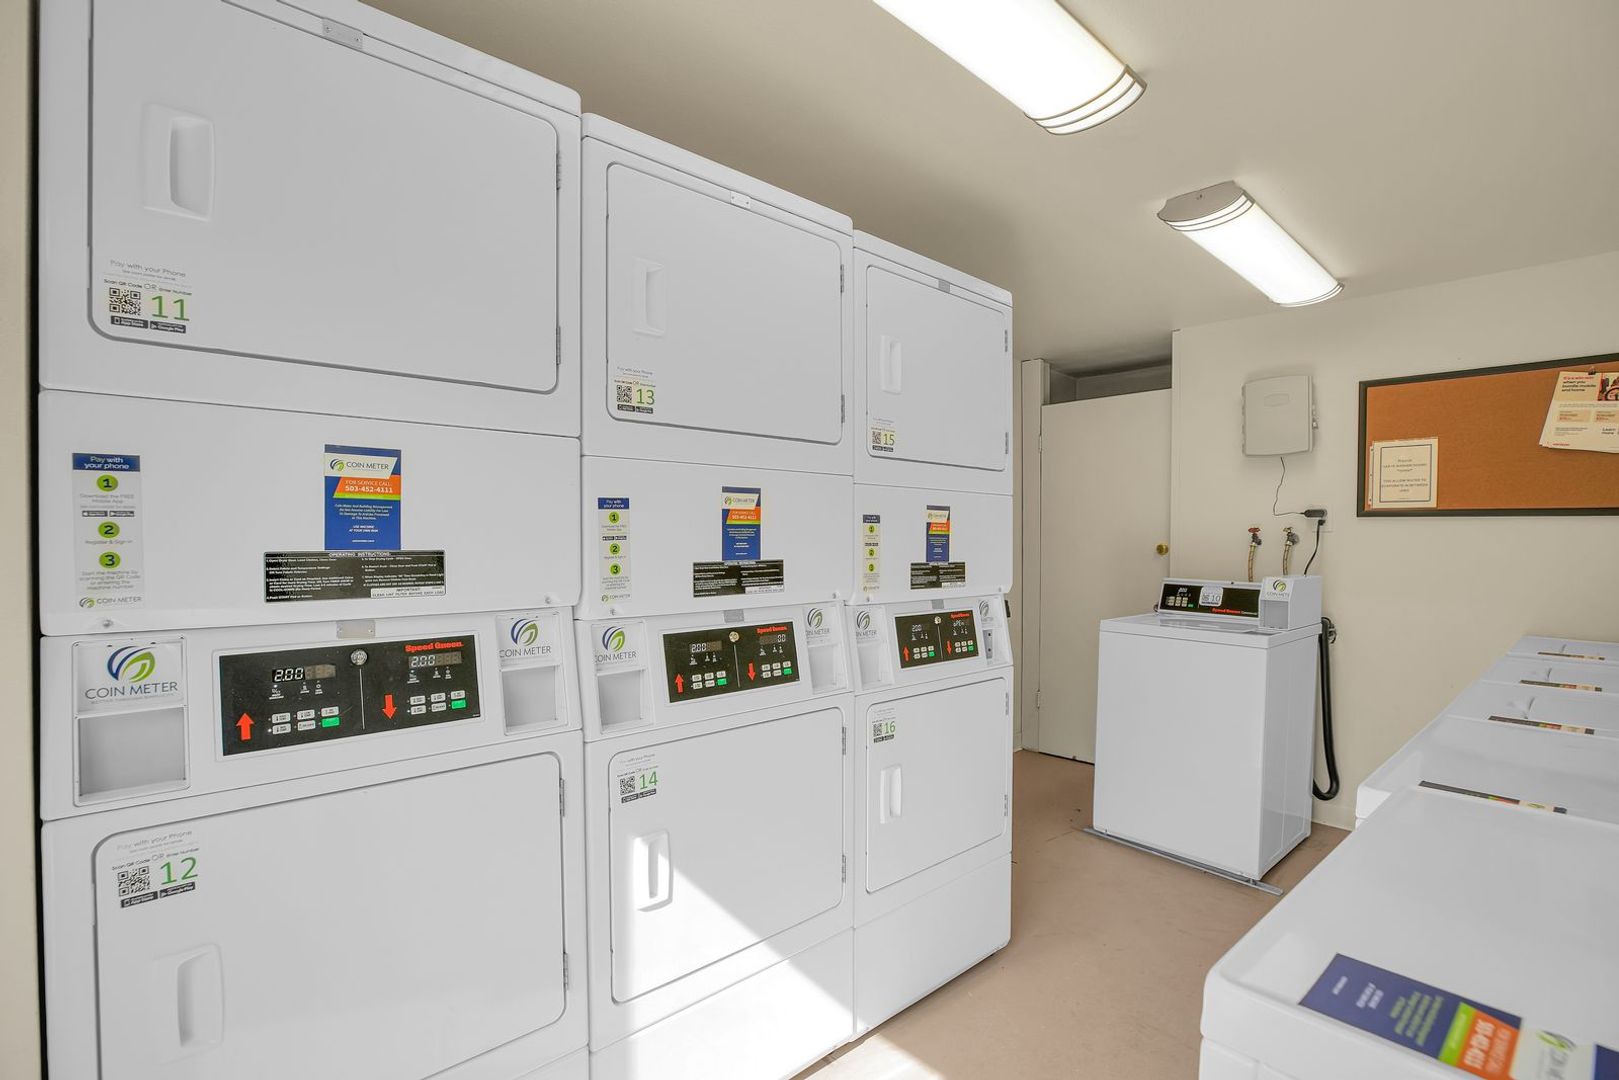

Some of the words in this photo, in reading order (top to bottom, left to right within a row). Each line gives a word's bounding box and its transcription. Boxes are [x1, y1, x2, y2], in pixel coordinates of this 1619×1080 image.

[162, 269, 186, 277] Phone
[152, 296, 190, 321] 11
[636, 388, 655, 405] 13
[884, 433, 895, 446] 15
[90, 456, 106, 464] Pay
[103, 478, 112, 488] 1
[104, 524, 114, 535] 2
[105, 554, 115, 566] 3
[613, 565, 618, 574] 3
[405, 643, 434, 652] Speed
[435, 641, 462, 649] Queen
[524, 646, 551, 656] METER
[411, 654, 436, 668] 2.00
[613, 651, 637, 660] METER
[274, 667, 304, 682] 2.00
[85, 686, 125, 699] COIN
[130, 682, 178, 695] METER
[885, 720, 896, 734] 16
[640, 771, 658, 789] 14
[160, 856, 198, 885] 12
